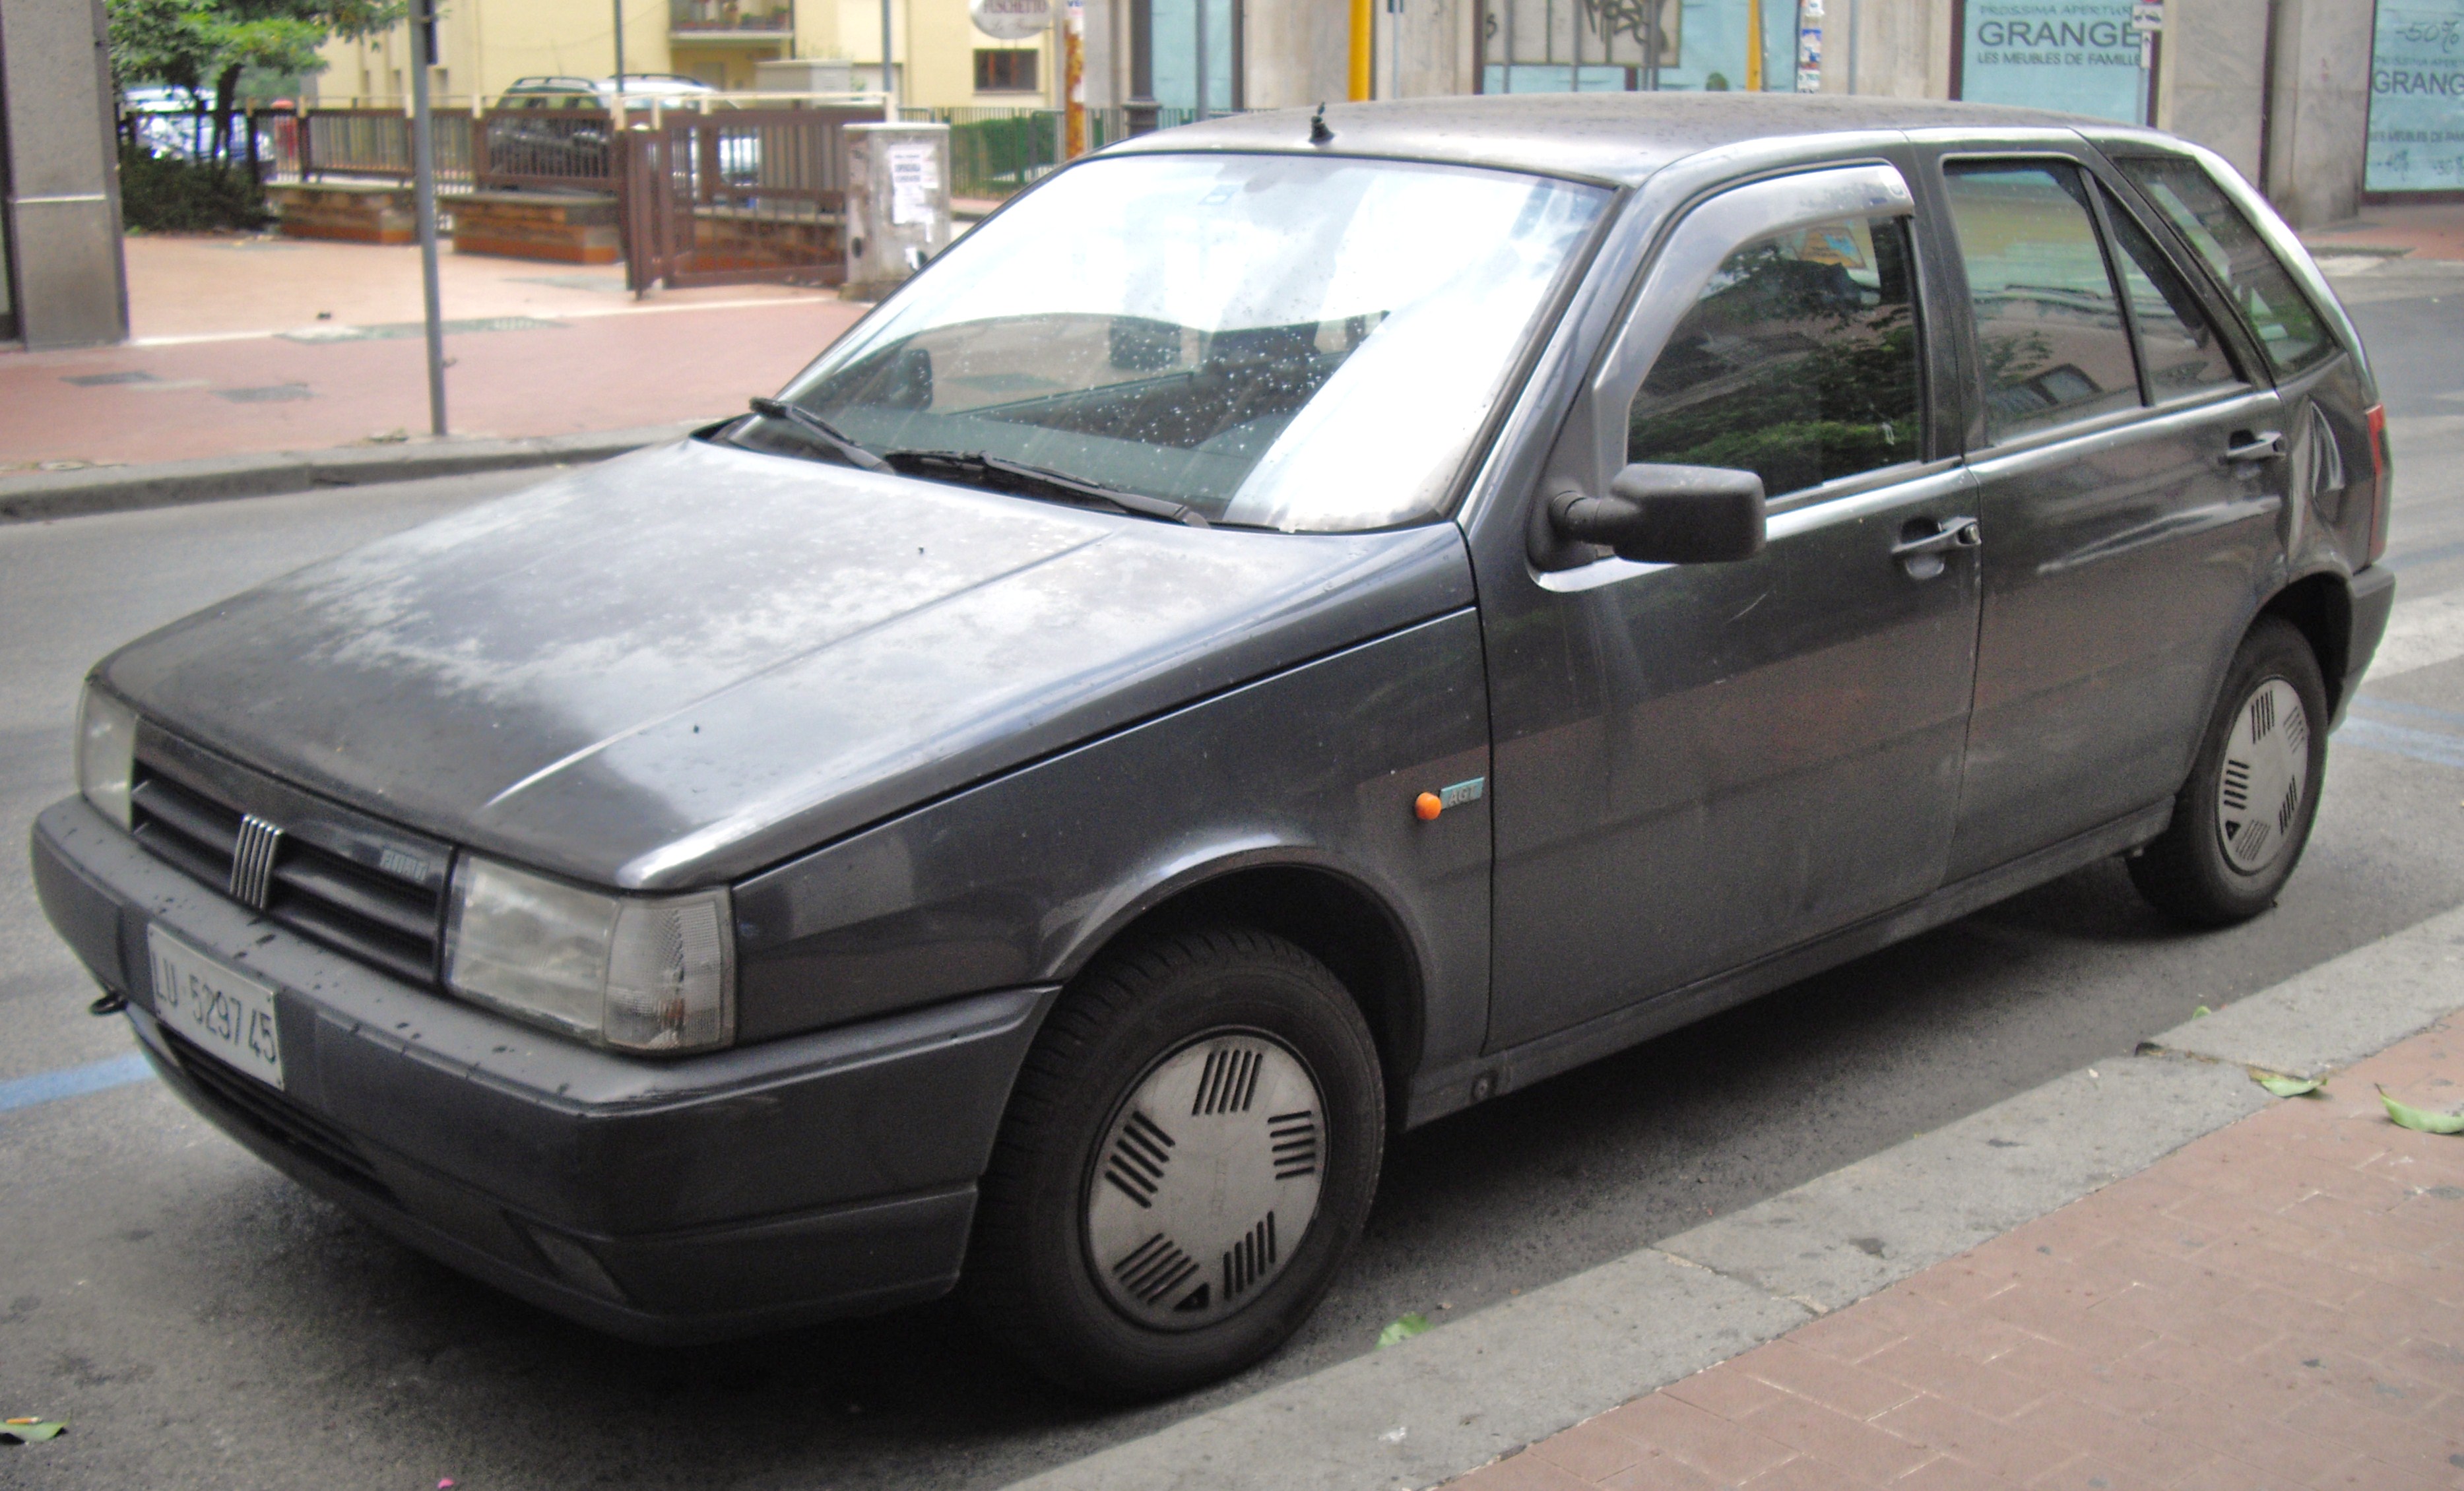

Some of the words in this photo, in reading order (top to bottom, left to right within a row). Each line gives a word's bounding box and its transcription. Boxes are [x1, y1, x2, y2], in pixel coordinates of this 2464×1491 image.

[1978, 21, 2141, 48] GRANGE
[1978, 52, 1999, 64] LES
[2003, 53, 2061, 65] MEUBLES
[2065, 53, 2083, 65] DE
[2373, 70, 2464, 96] GRANG
[152, 951, 178, 1008] LU
